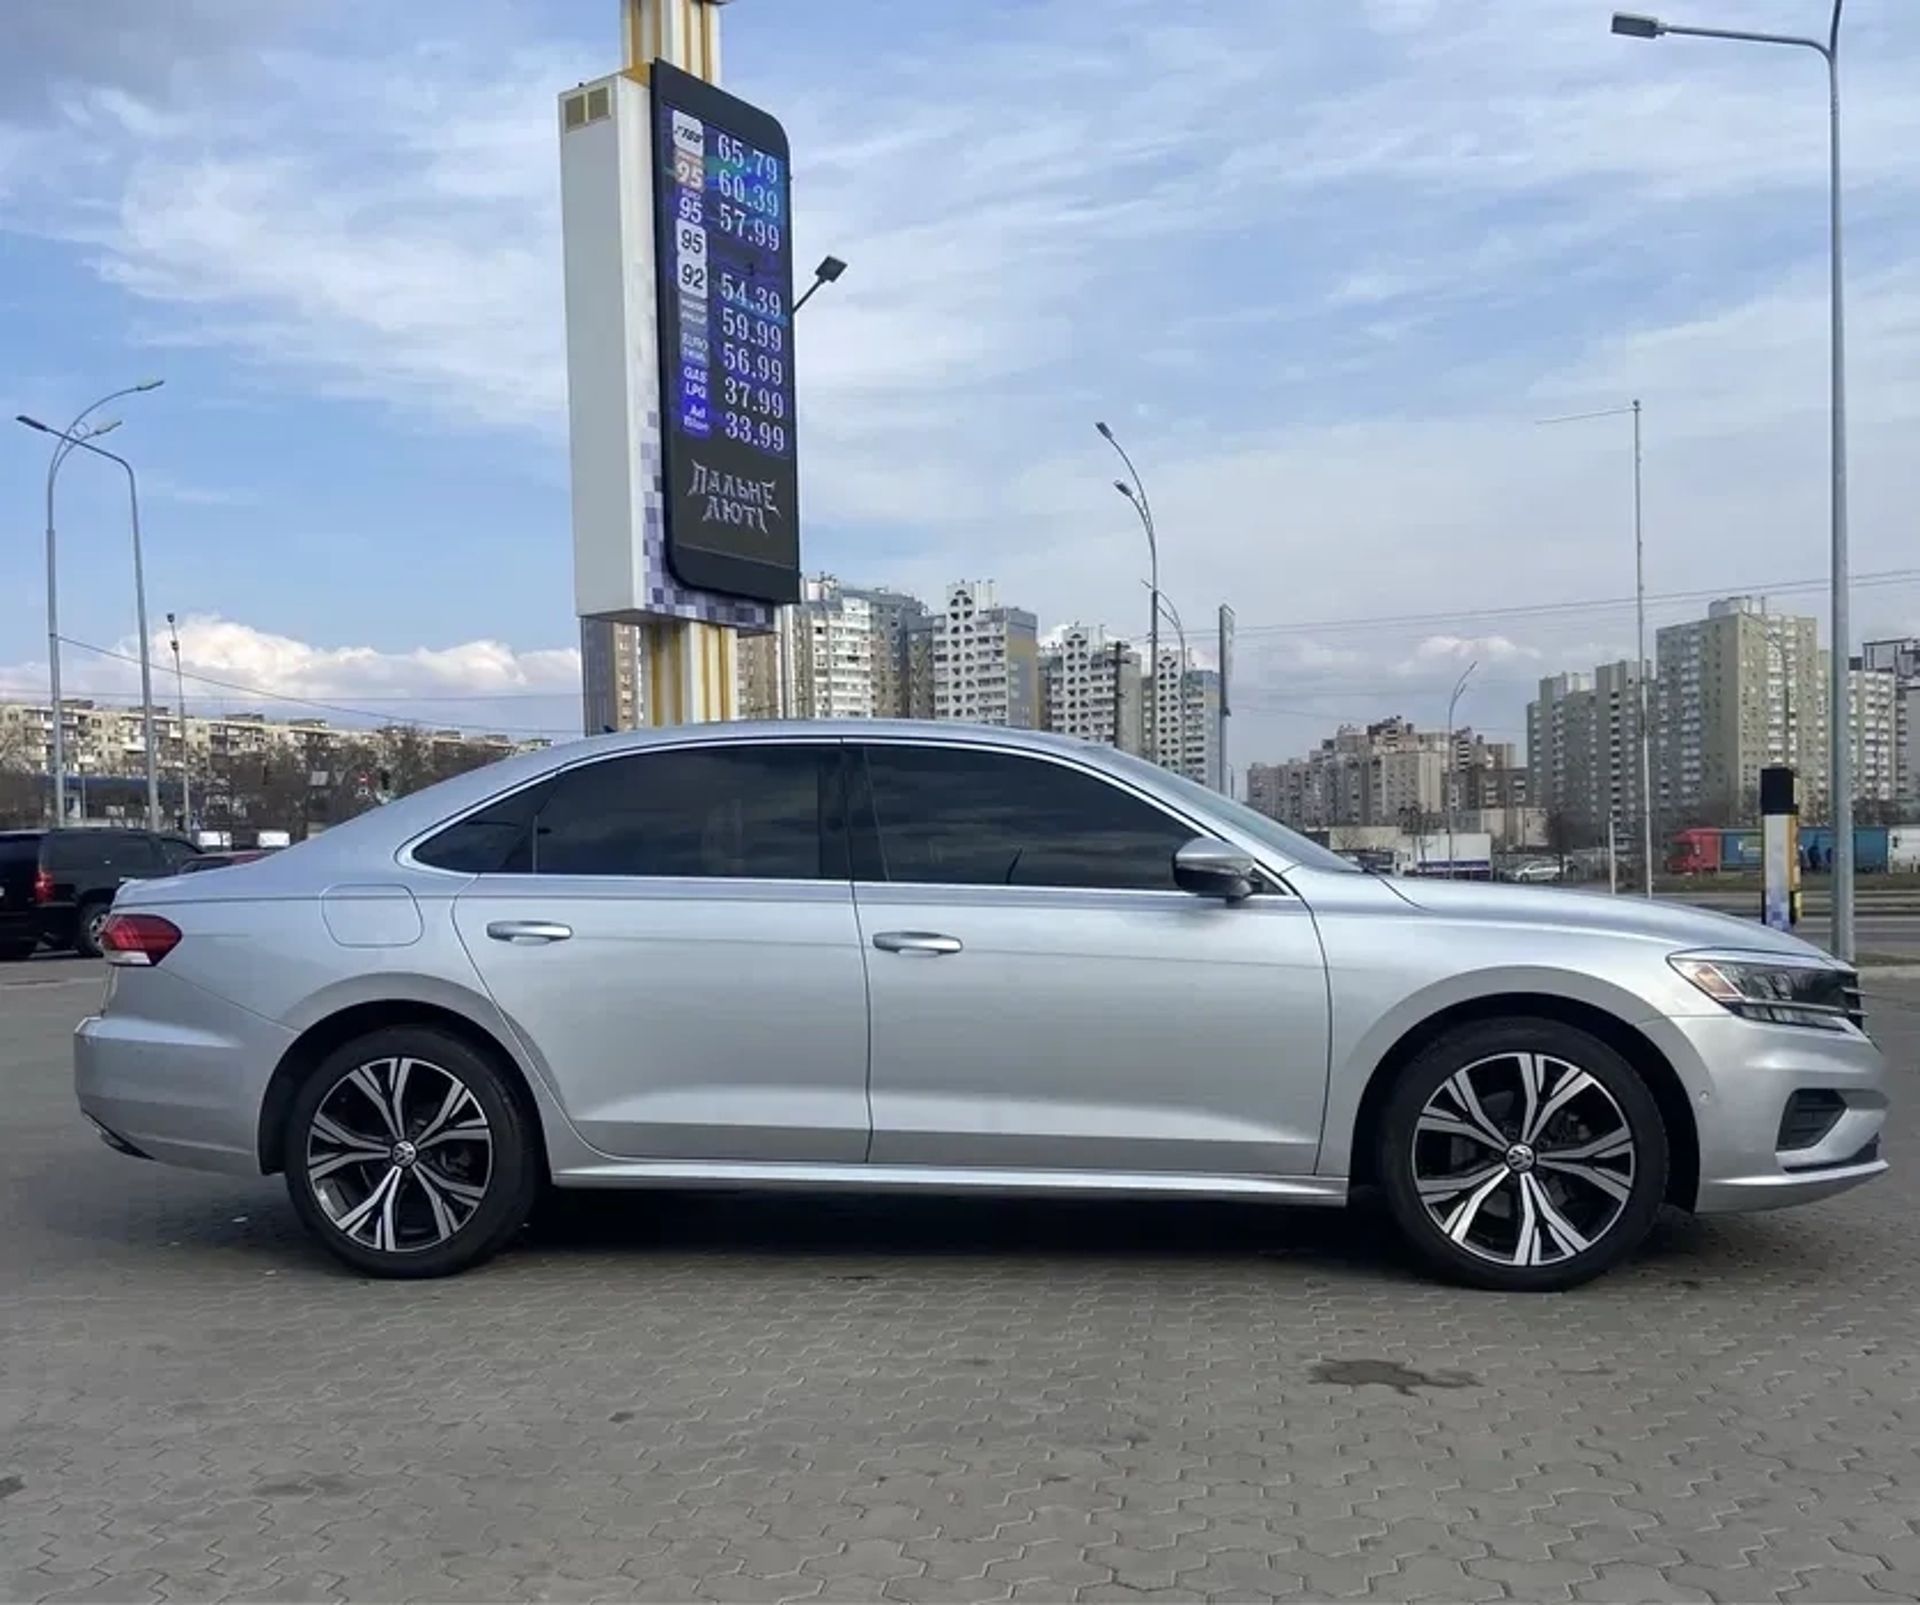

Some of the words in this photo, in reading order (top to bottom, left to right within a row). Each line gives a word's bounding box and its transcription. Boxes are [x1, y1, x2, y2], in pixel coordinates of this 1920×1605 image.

[676, 162, 703, 187] 95
[718, 134, 777, 183] 65.79
[679, 197, 703, 223] 95
[719, 168, 778, 217] 60.39
[681, 229, 703, 254] 95
[719, 203, 780, 251] 57.99
[681, 263, 705, 288] 92
[721, 273, 781, 317] 54.39
[722, 308, 782, 352] 59.99
[723, 342, 783, 386] 56.99
[724, 377, 784, 418] 37.99
[725, 412, 785, 452] 33.99
[687, 459, 781, 518] ПАЛЬНЕ
